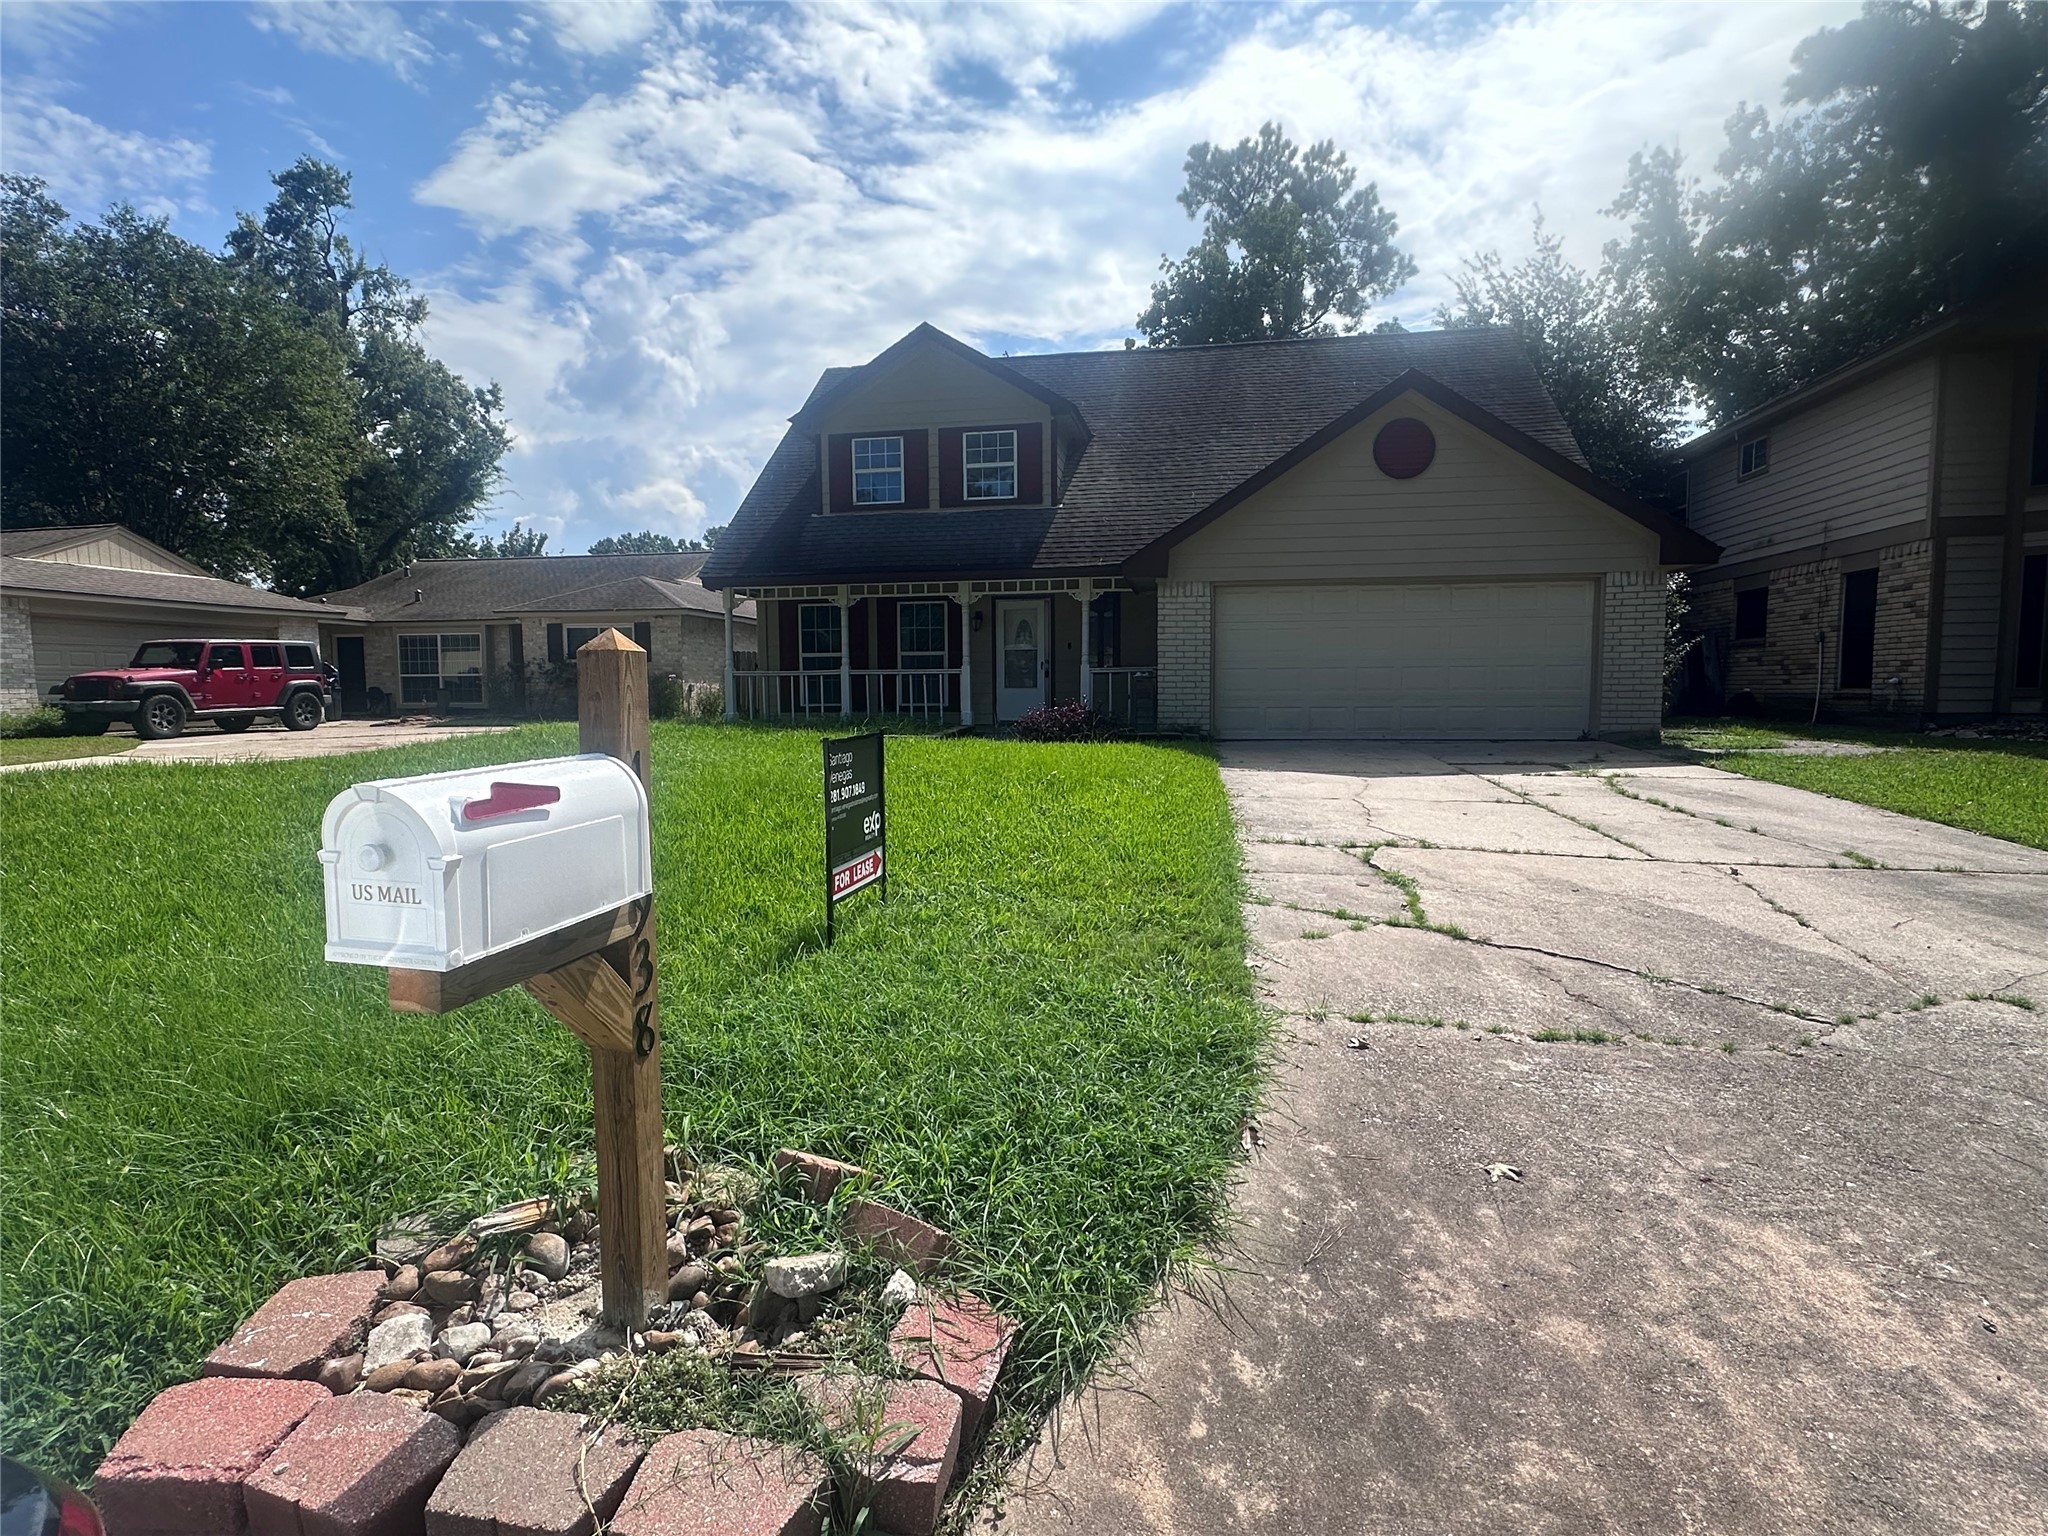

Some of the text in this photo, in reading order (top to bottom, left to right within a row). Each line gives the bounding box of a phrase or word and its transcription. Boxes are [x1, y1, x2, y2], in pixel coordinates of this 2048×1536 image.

[834, 857, 874, 892] FOR LEASE
[351, 883, 422, 905] US MAIL
